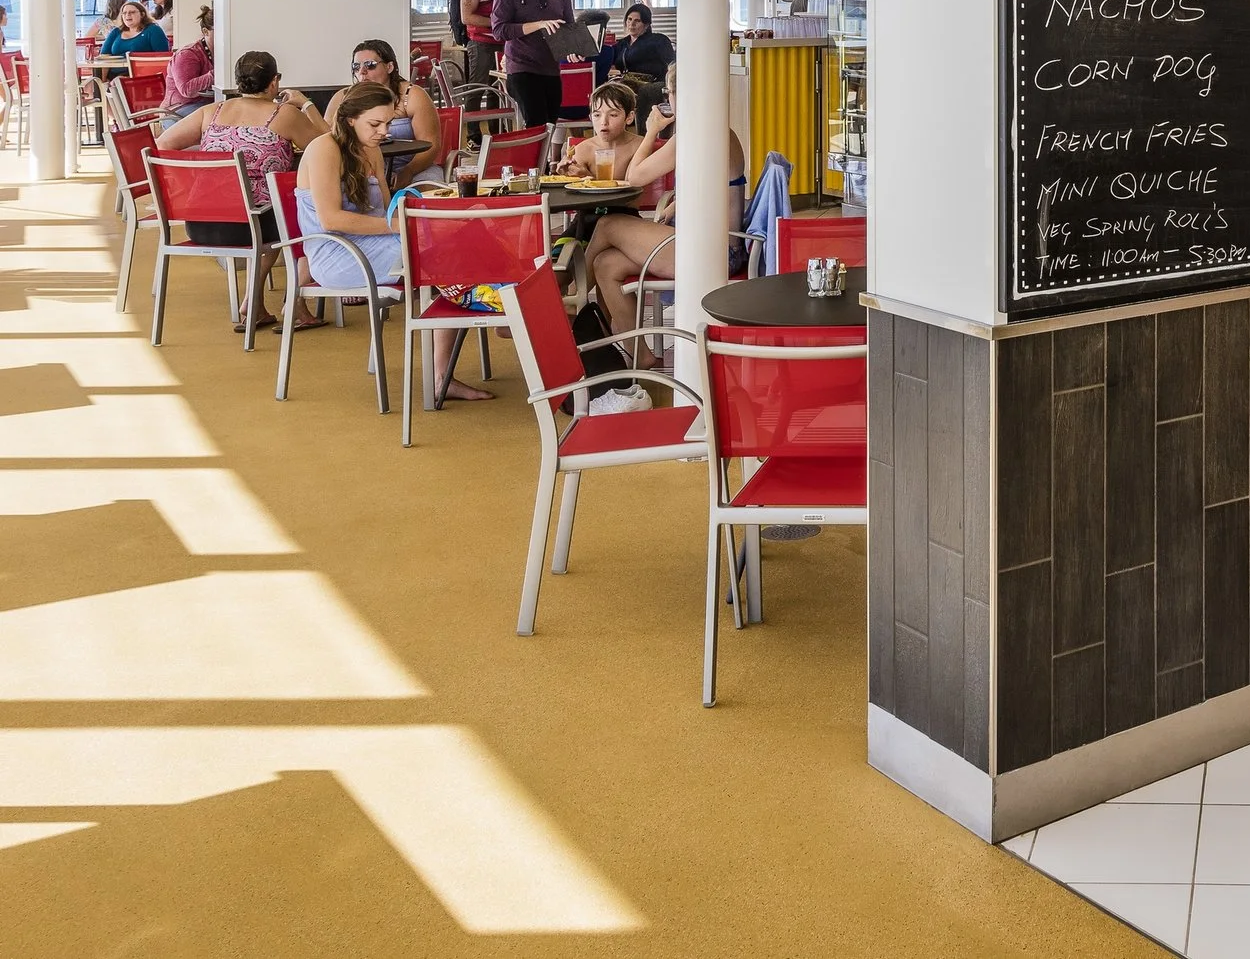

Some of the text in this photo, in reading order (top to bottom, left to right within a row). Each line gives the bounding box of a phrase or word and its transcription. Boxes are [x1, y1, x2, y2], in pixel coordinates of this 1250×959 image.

[1034, 53, 1216, 97] CORN DOG
[1035, 121, 1229, 159] FRENCH FRIES
[1036, 167, 1218, 210] MINI QUICHE
[1037, 222, 1072, 245] VEG
[1082, 214, 1156, 243] SPRING
